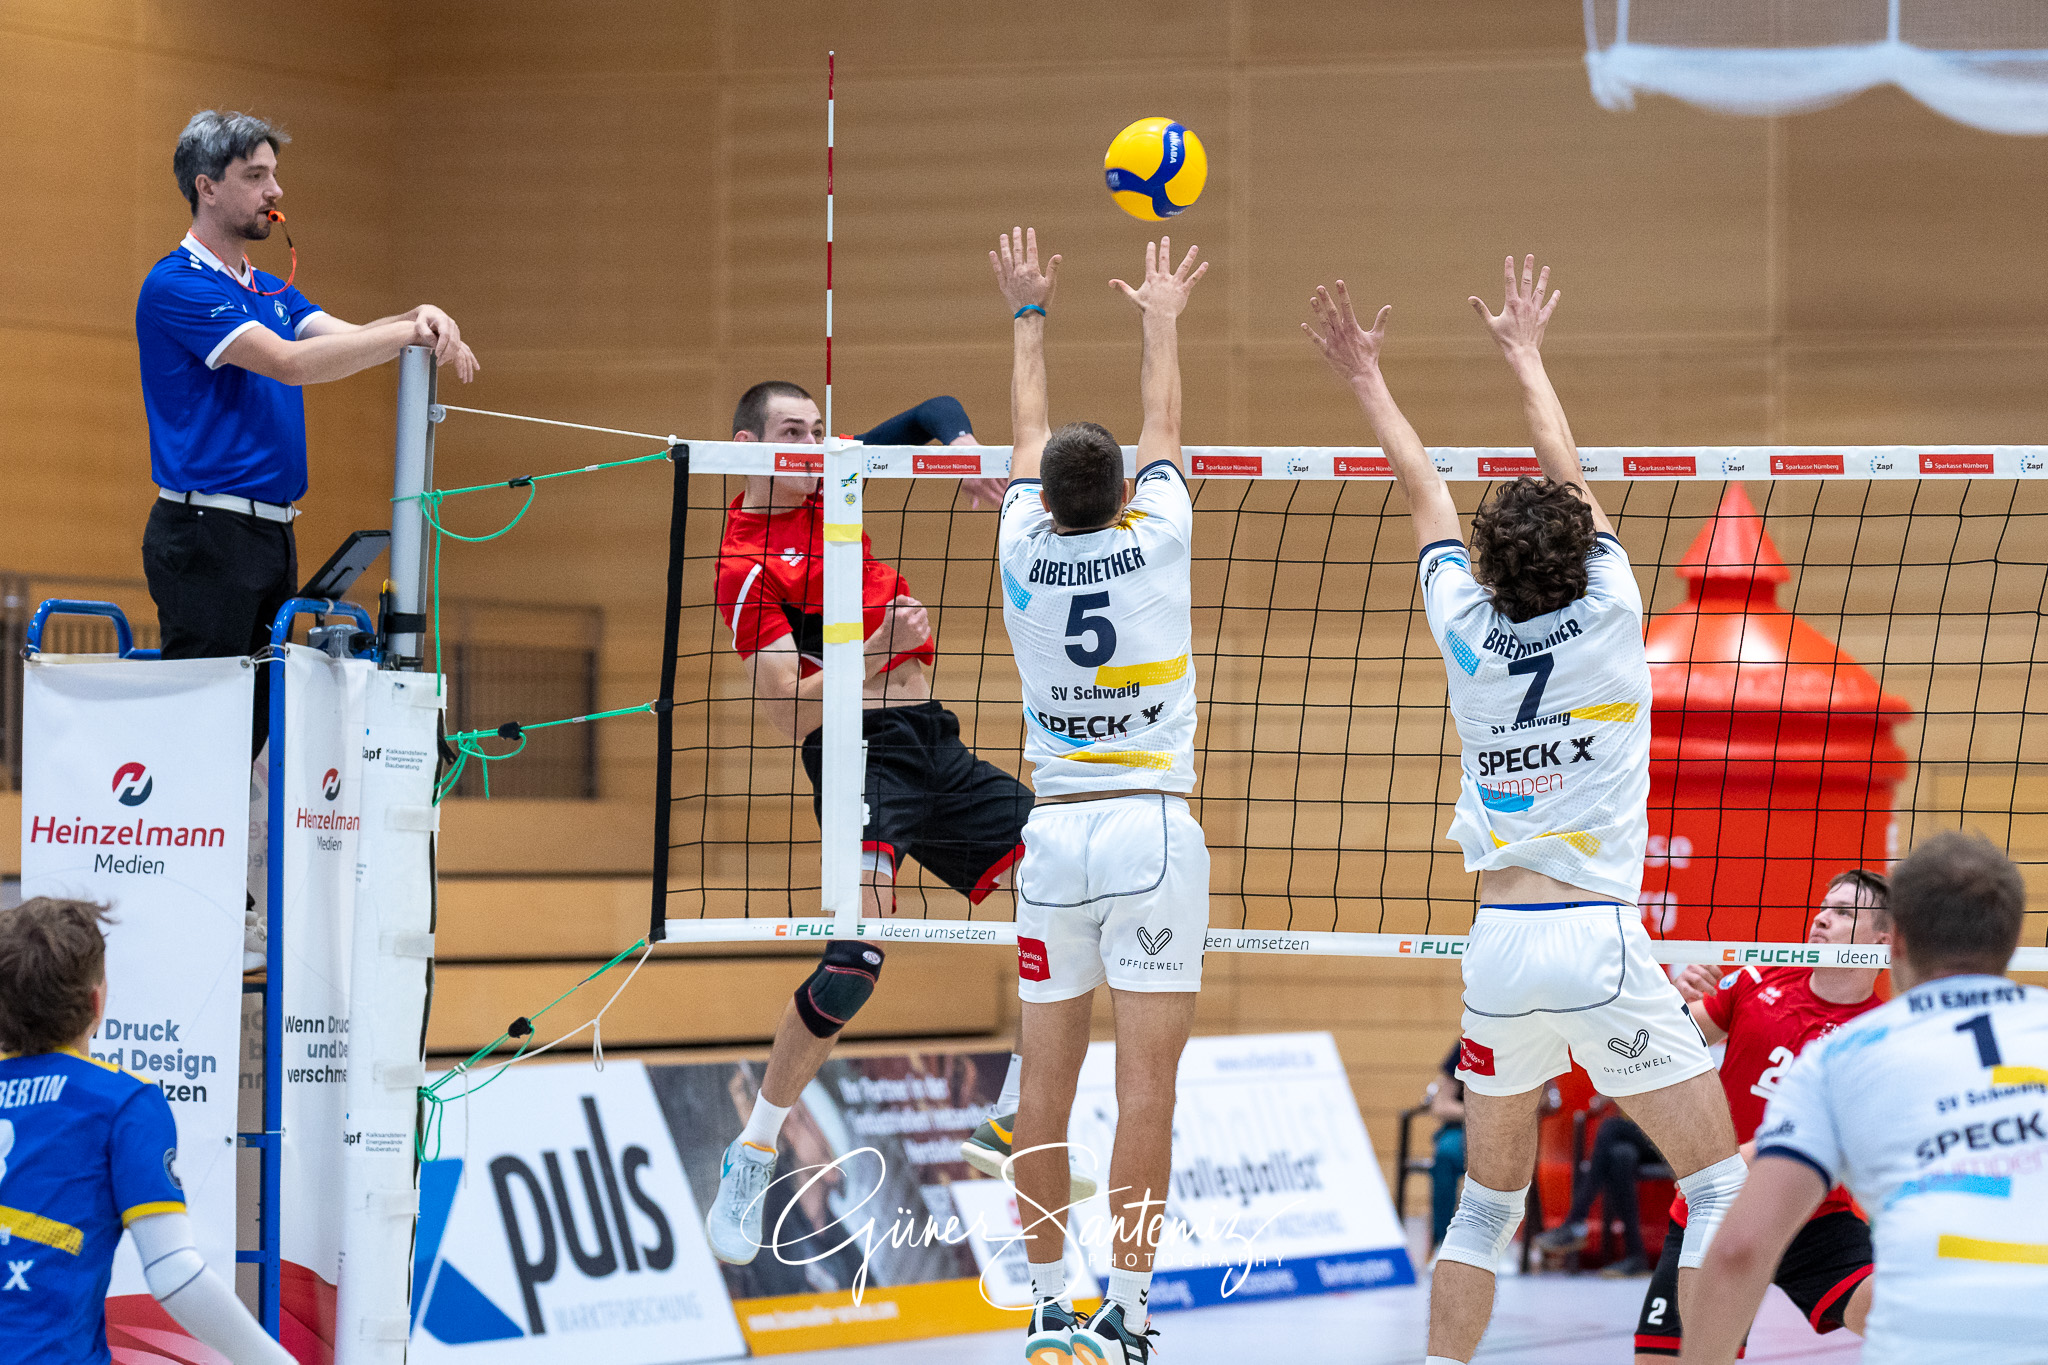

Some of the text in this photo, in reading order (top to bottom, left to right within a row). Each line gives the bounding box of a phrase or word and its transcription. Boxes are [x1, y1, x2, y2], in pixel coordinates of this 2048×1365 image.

[788, 461, 814, 470] Sparkae
[872, 463, 889, 471] Zapf
[952, 463, 977, 471] Nürnberg
[1233, 464, 1258, 472] Nürnberg
[1293, 465, 1309, 473] Zapf
[1436, 465, 1453, 473] Zapf
[1492, 465, 1520, 473] Sparkasse
[1581, 465, 1598, 473] Zapf
[1728, 464, 1745, 472] Zapf
[1785, 463, 1839, 471] Sparkasse Nürnberg
[1876, 463, 1893, 471] Zapf
[1934, 462, 1989, 470] Sparkasse Nürnberg
[2026, 462, 2044, 470] Zapf
[1029, 545, 1147, 587] BIBELRIETHER
[1064, 590, 1117, 669] 5
[1051, 680, 1140, 701] SV Schwaig
[1507, 652, 1555, 723] 7
[384, 762, 420, 771] Bauberatung
[1477, 740, 1562, 777] SPECK
[1481, 773, 1563, 805] pumpen
[296, 807, 360, 831] Heinzelman
[30, 814, 226, 849] Heinzelmann
[317, 836, 342, 851] Medien
[93, 853, 165, 875] Medien
[795, 923, 997, 941] FUCS Ideen umsetzen
[1204, 936, 1310, 951] een umsetzen
[1421, 941, 1470, 955] FUC
[1119, 957, 1184, 971] OFFICEWELT
[1745, 949, 1820, 963] FUCHS
[1836, 949, 1879, 965] Ideen
[105, 1018, 180, 1042] Druck
[284, 1015, 349, 1034] Wenn Druc
[1955, 1013, 2002, 1068] 1
[307, 1040, 337, 1059] und
[131, 1048, 217, 1080] Design
[1915, 1109, 2047, 1163] SPECK
[487, 1095, 677, 1336] puls
[1647, 1297, 1667, 1326] 2
